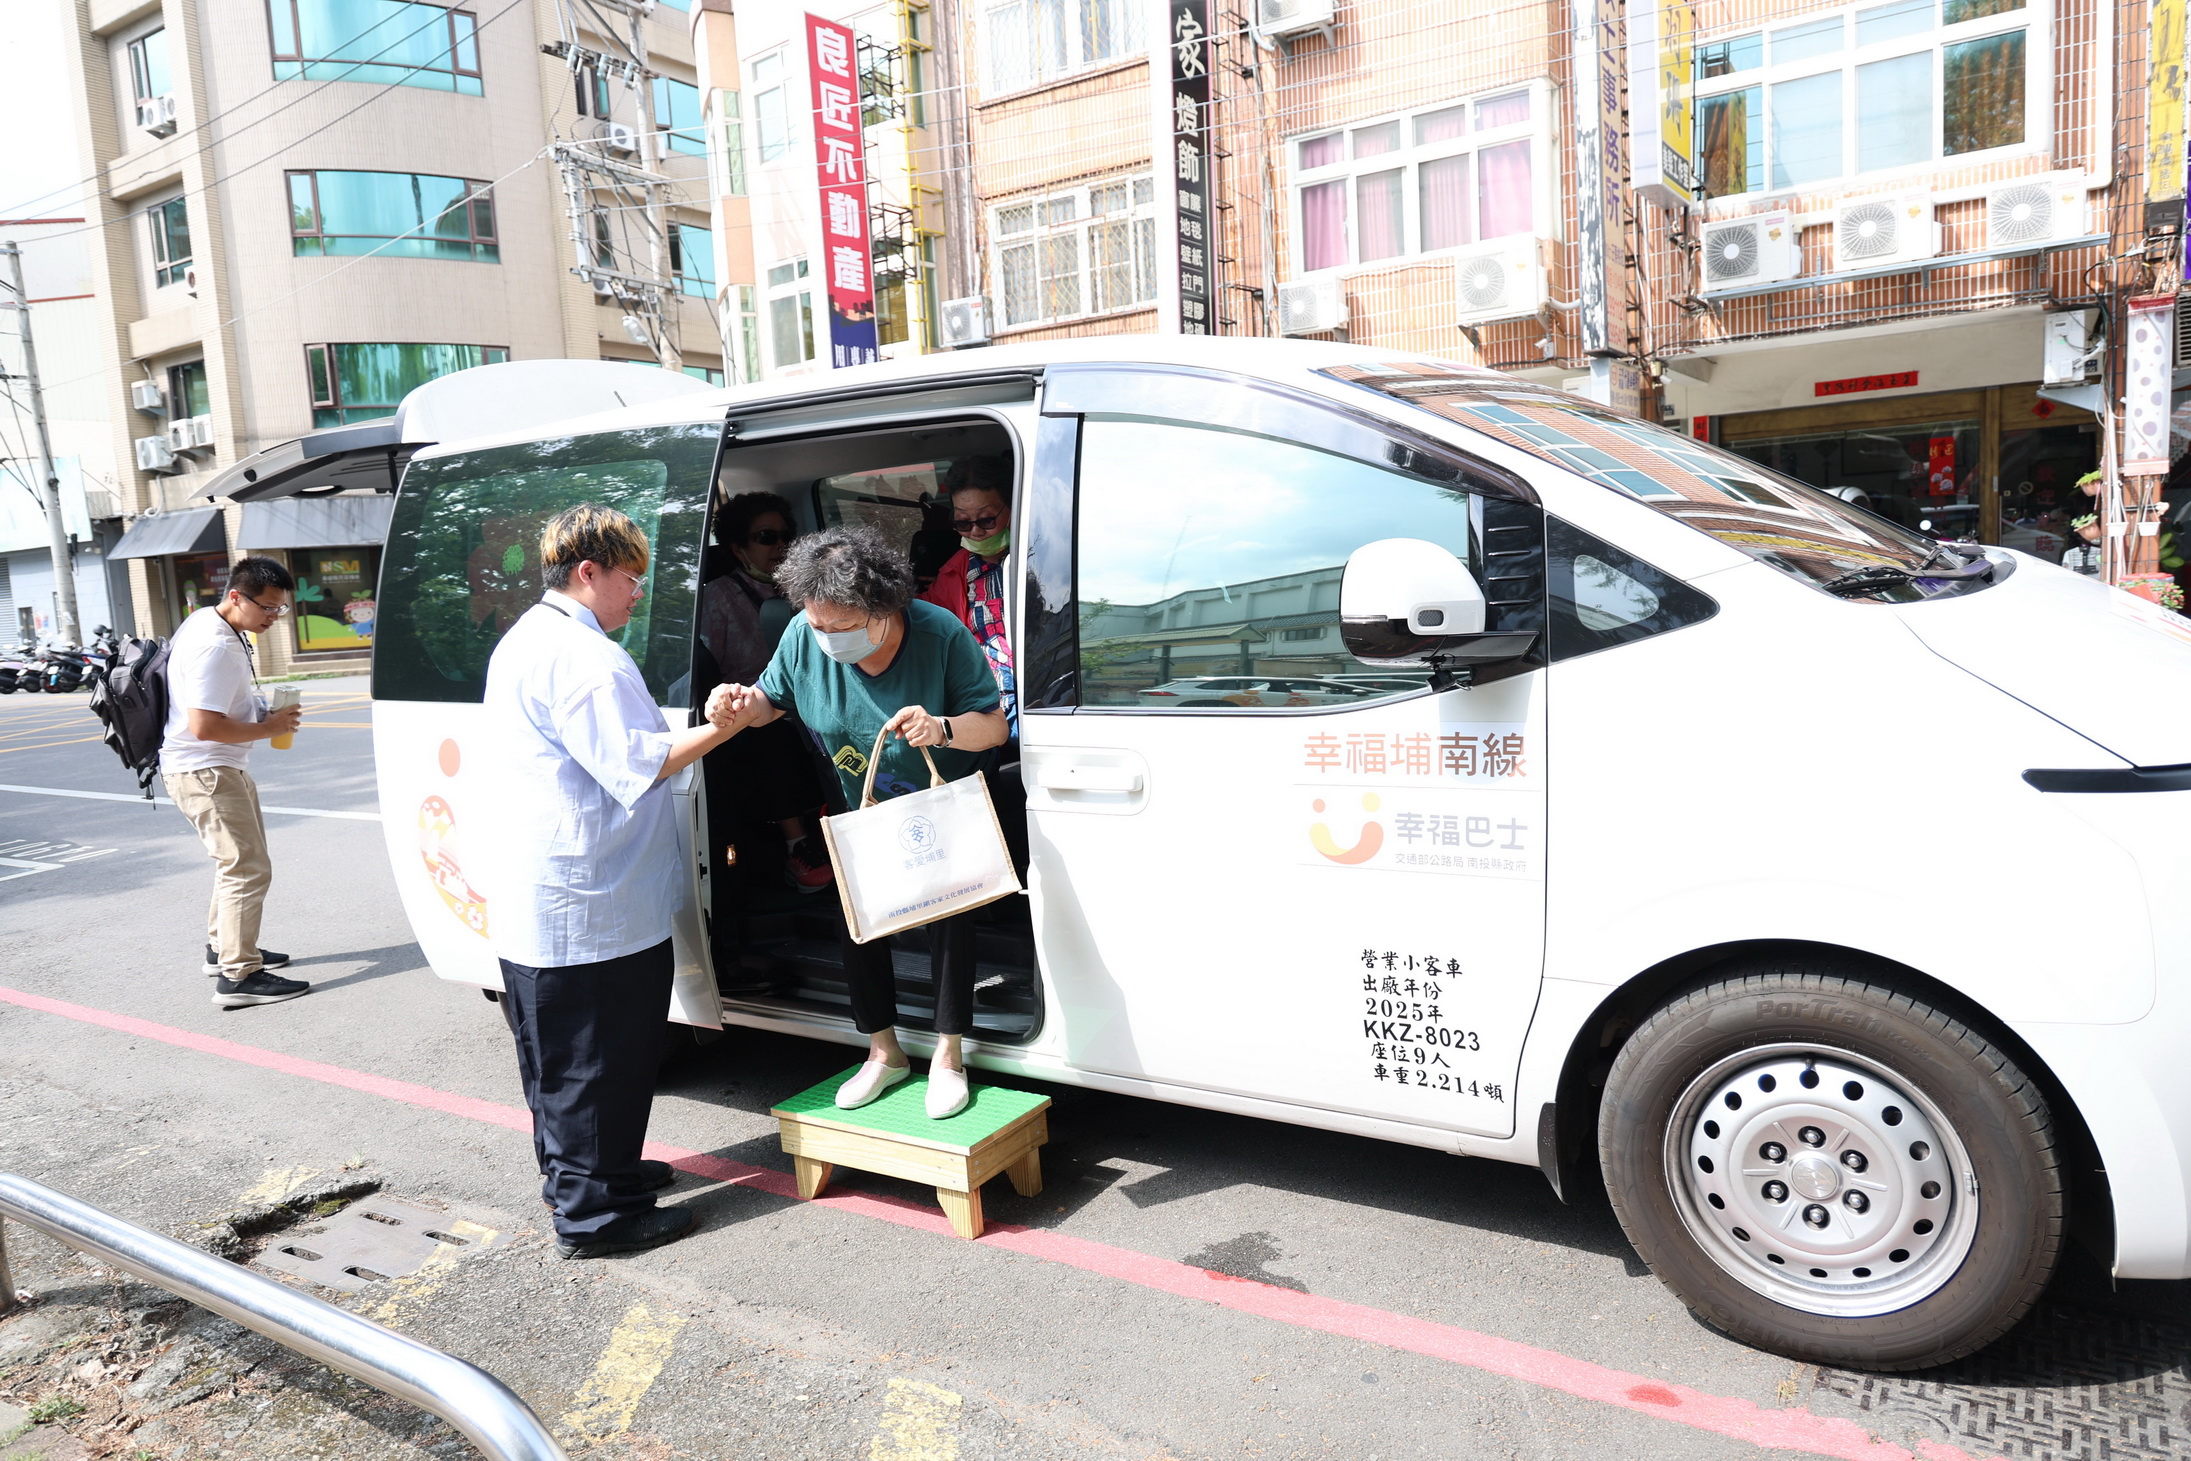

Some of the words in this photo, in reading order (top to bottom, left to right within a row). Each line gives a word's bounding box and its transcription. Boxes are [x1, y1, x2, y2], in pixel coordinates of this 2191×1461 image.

[1601, 0, 1620, 227] 士事務所
[815, 25, 866, 292] 良匠不動產
[1179, 216, 1203, 240] 地毯
[1180, 244, 1204, 267] 壁紙
[1181, 272, 1204, 294] 拉門
[1304, 731, 1527, 777] 幸福埔南線
[1395, 812, 1528, 850] 幸福巴士
[903, 848, 947, 870] 客愛埔里
[1395, 852, 1464, 868] 交通部公路局
[1467, 857, 1527, 872] 南投縣政府
[1361, 949, 1463, 978] 營業小客車
[1363, 974, 1442, 1000] 出廠年份
[1366, 998, 1443, 1024] 2025年
[1756, 998, 1883, 1034] PorTran
[1364, 1020, 1480, 1051] KKZ-8023
[1371, 1041, 1451, 1068] 座位9人
[1374, 1063, 1504, 1103] 車重2.214噸
